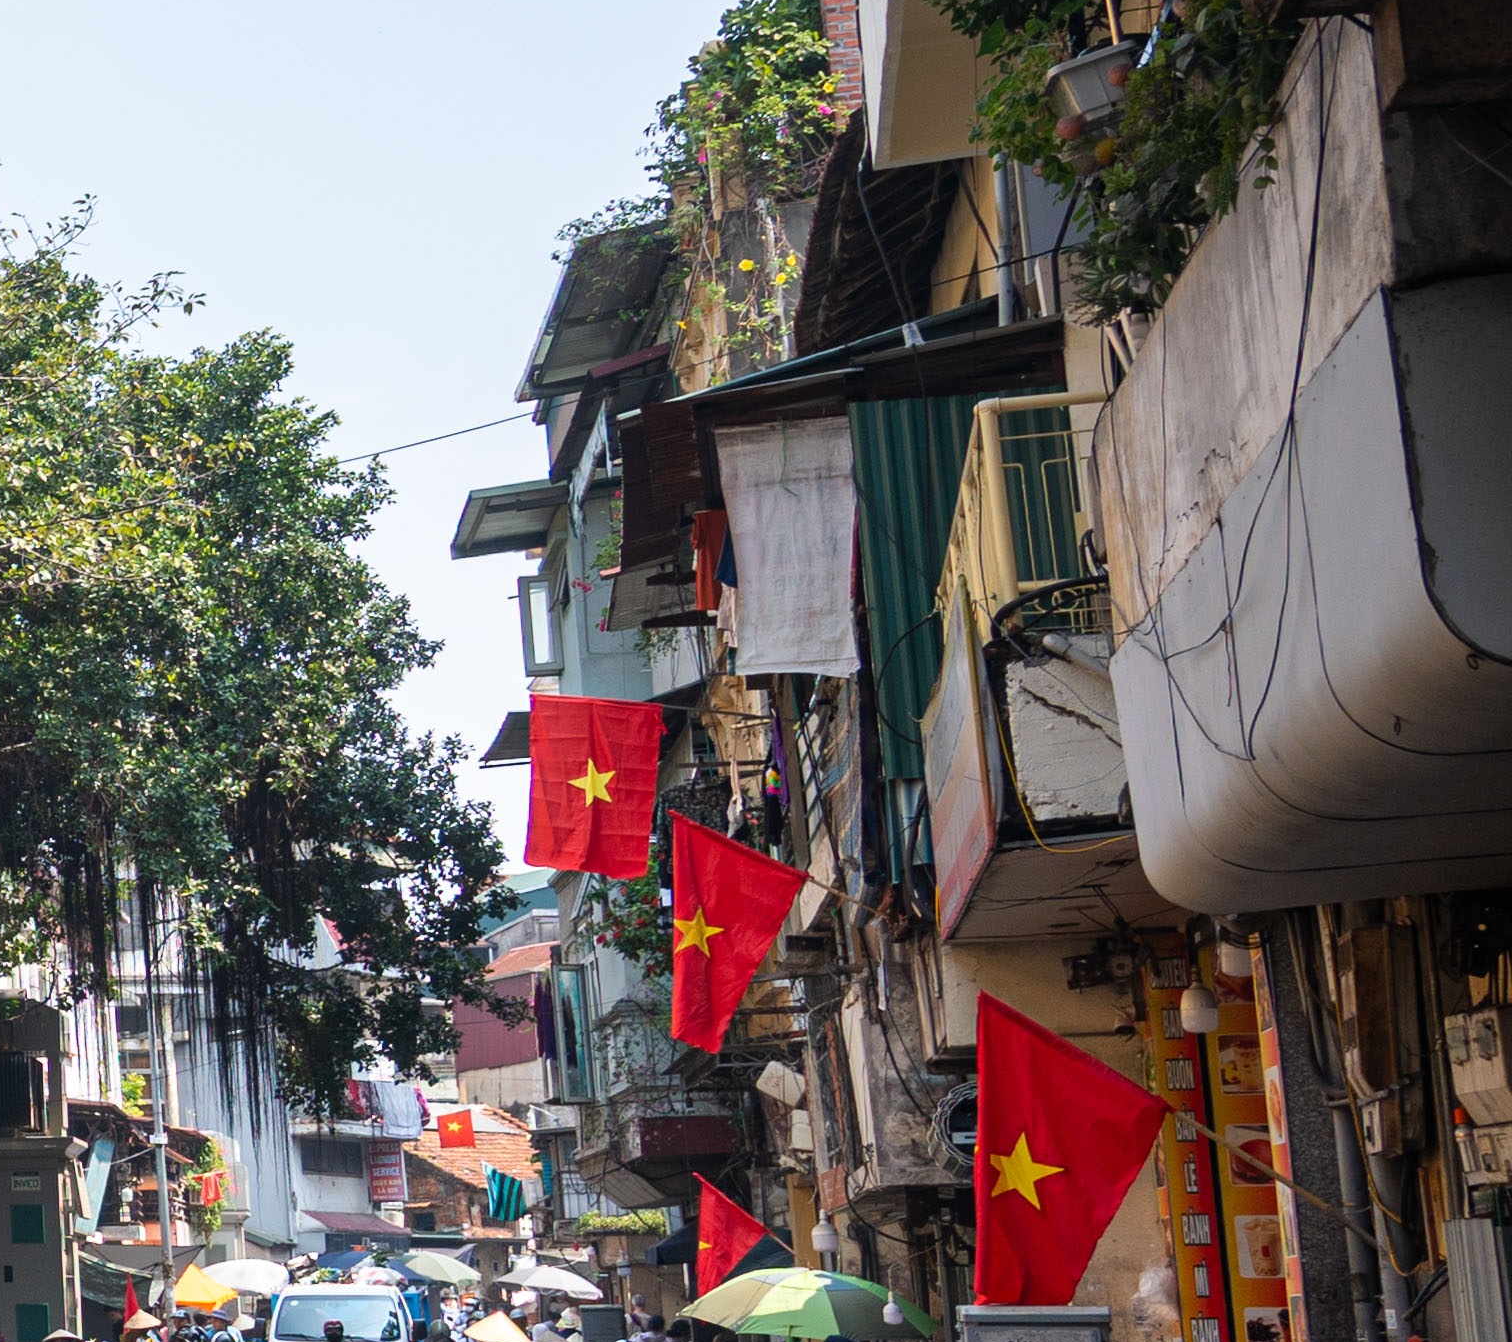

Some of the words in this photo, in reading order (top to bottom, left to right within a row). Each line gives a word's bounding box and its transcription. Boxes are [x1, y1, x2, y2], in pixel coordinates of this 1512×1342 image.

[1166, 1053, 1196, 1090] BUÔN
[1184, 1152, 1198, 1193] LẺ
[1182, 1206, 1211, 1245] BÁNH
